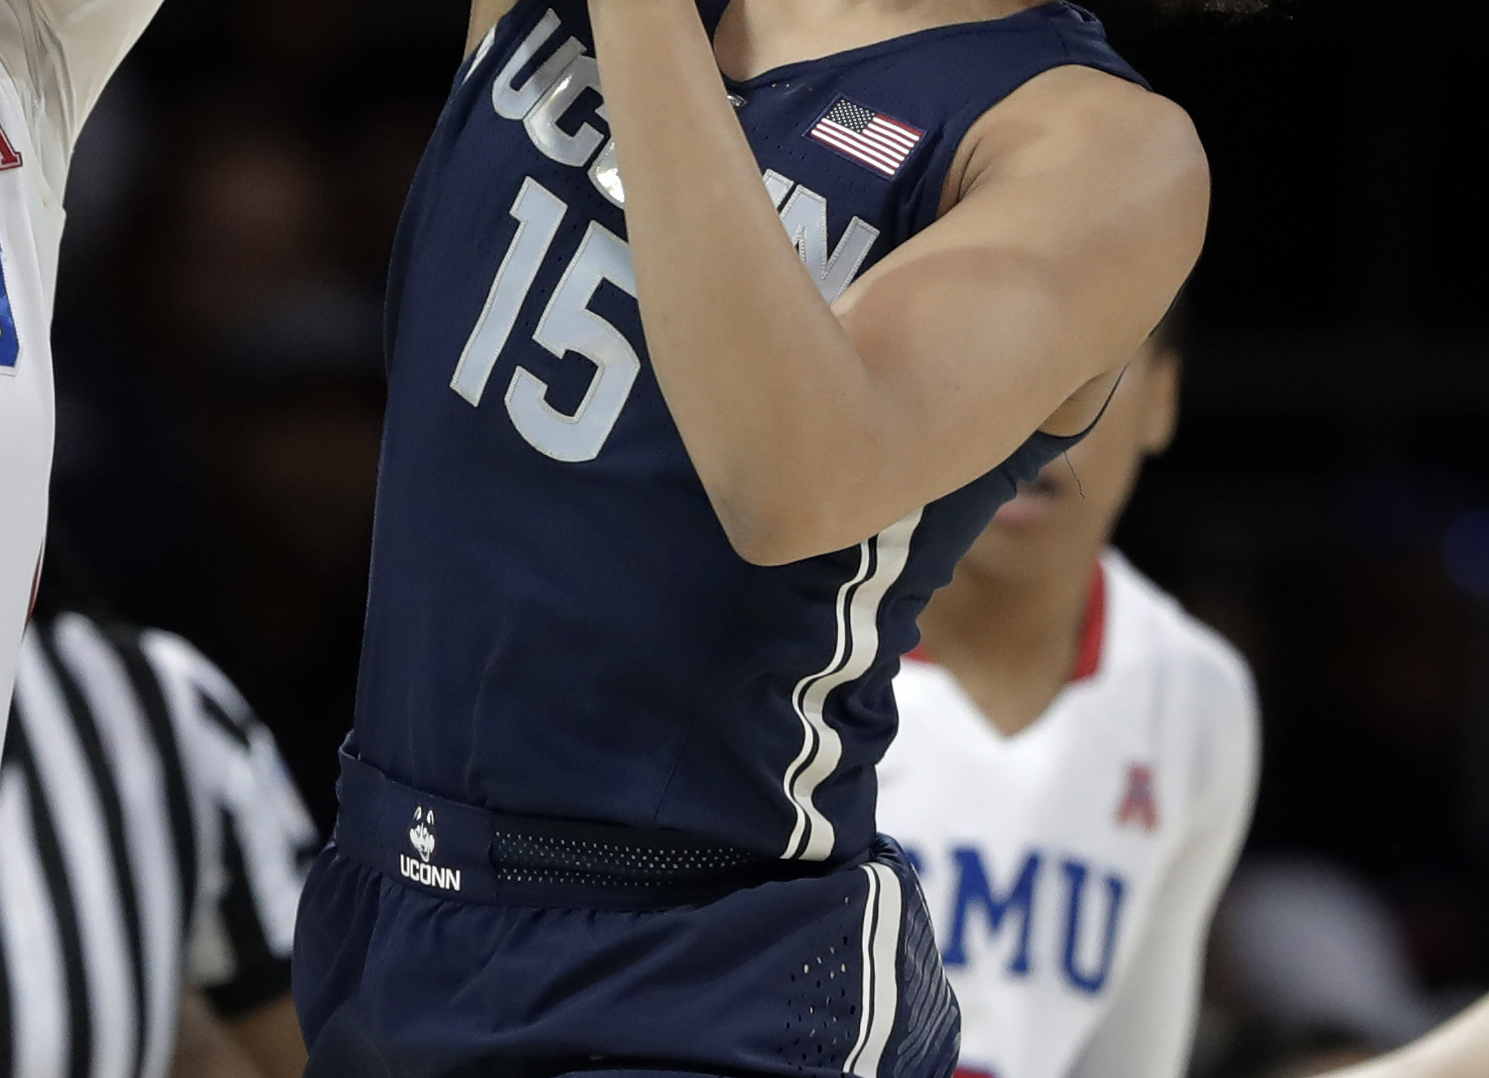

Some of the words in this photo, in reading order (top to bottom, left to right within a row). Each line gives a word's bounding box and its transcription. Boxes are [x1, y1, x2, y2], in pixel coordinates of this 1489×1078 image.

[491, 7, 881, 307] UCN
[449, 174, 642, 464] 15
[399, 853, 461, 892] UCONN
[910, 840, 1132, 997] MU
